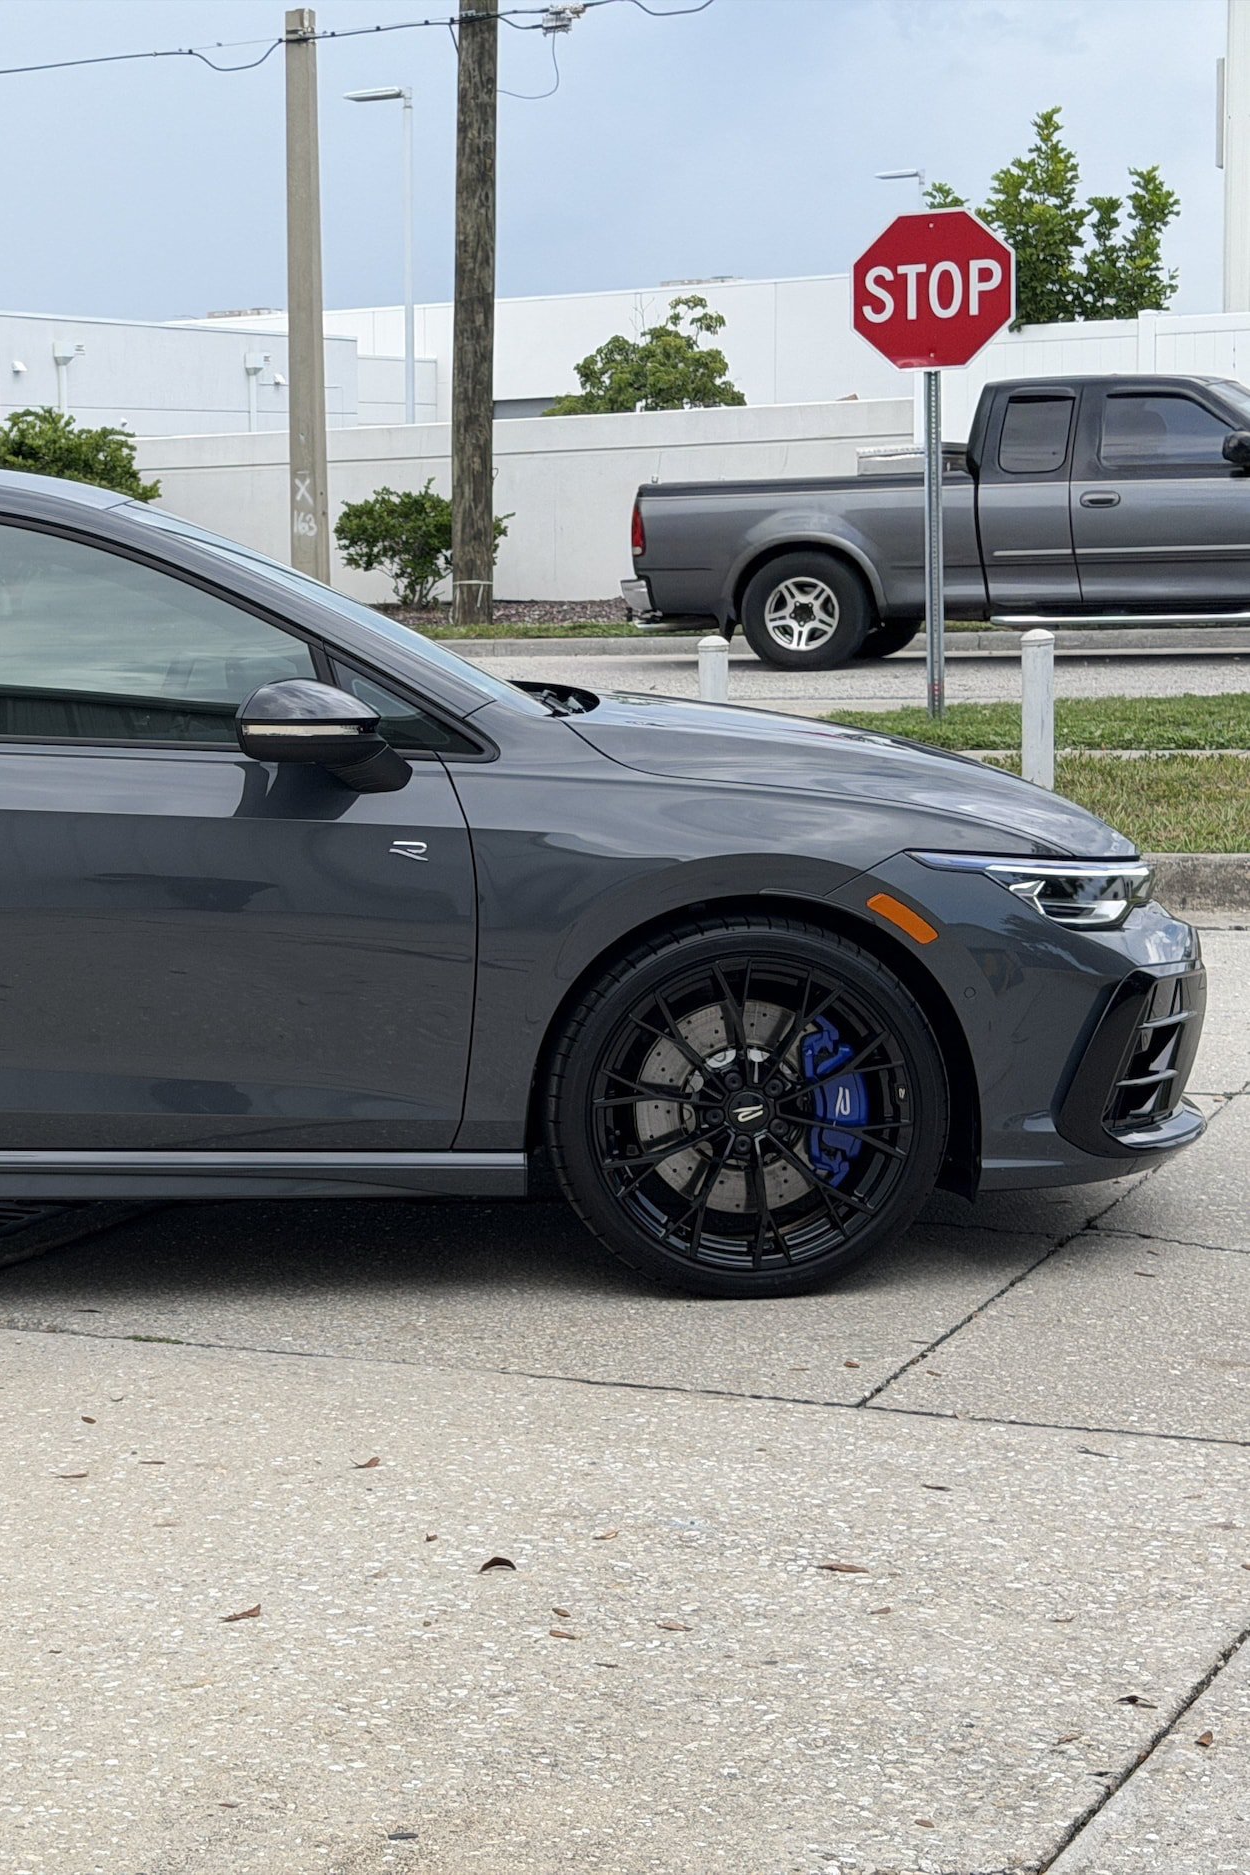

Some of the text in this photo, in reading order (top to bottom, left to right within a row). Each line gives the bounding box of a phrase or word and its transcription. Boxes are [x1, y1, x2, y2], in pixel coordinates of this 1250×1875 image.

[862, 259, 1002, 323] STOP
[294, 478, 314, 505] X
[293, 510, 317, 537] 163
[388, 841, 429, 862] R
